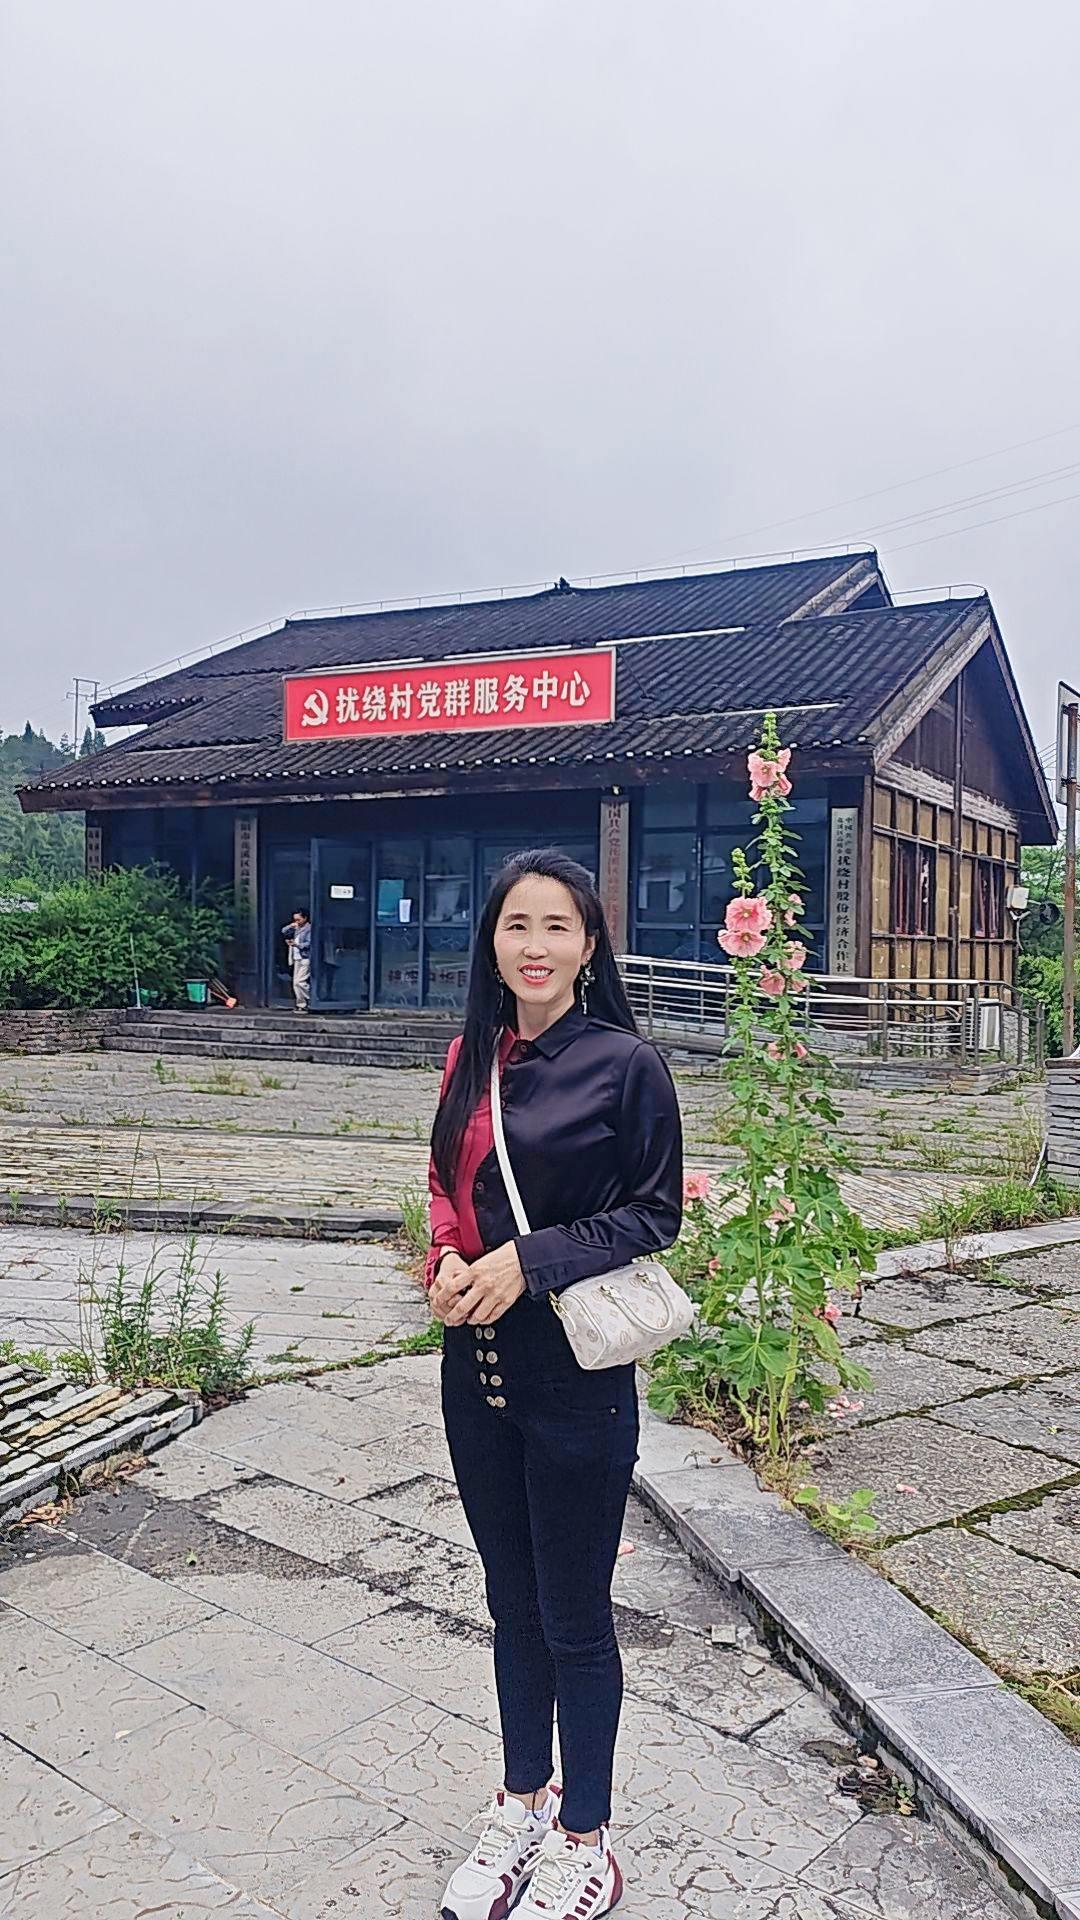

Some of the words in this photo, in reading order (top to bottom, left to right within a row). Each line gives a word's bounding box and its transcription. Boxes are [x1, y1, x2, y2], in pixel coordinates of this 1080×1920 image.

[336, 670, 591, 723] 扰绕村党群服务中心
[836, 856, 851, 972] 扰绕村股份经济合作社
